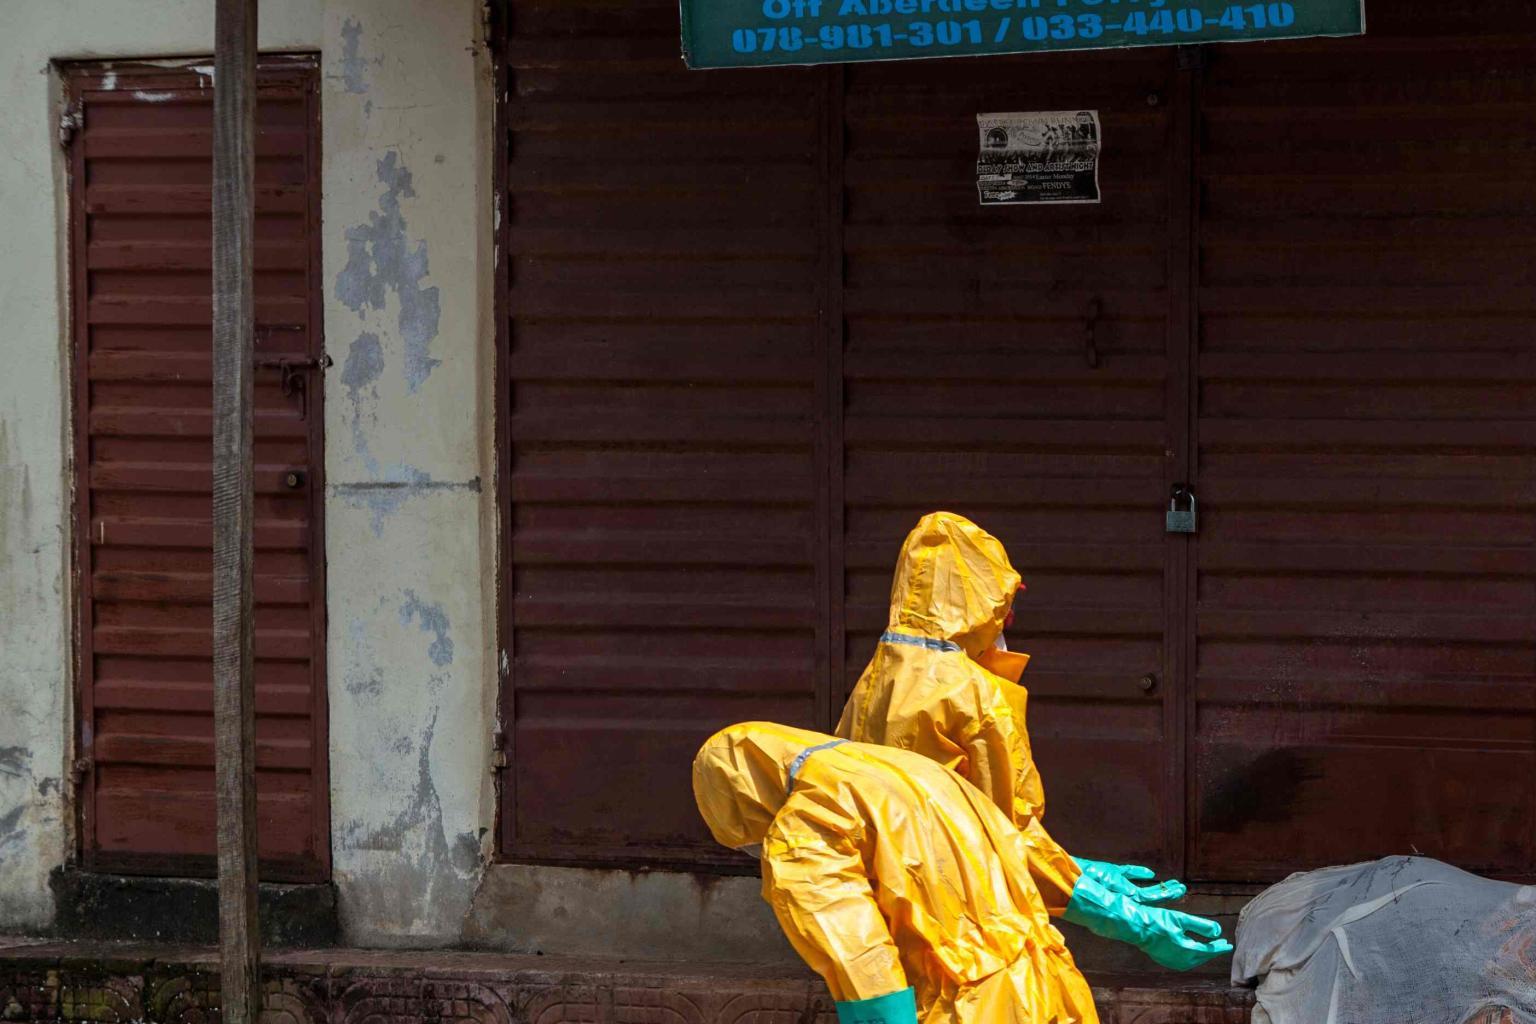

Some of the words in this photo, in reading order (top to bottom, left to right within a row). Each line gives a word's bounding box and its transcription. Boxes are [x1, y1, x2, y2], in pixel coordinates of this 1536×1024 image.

[762, 0, 823, 20] Off
[732, 19, 983, 53] 078-981-301
[994, 17, 1011, 43] /
[1022, 2, 1296, 41] 033-440-410
[1026, 162, 1043, 172] AND
